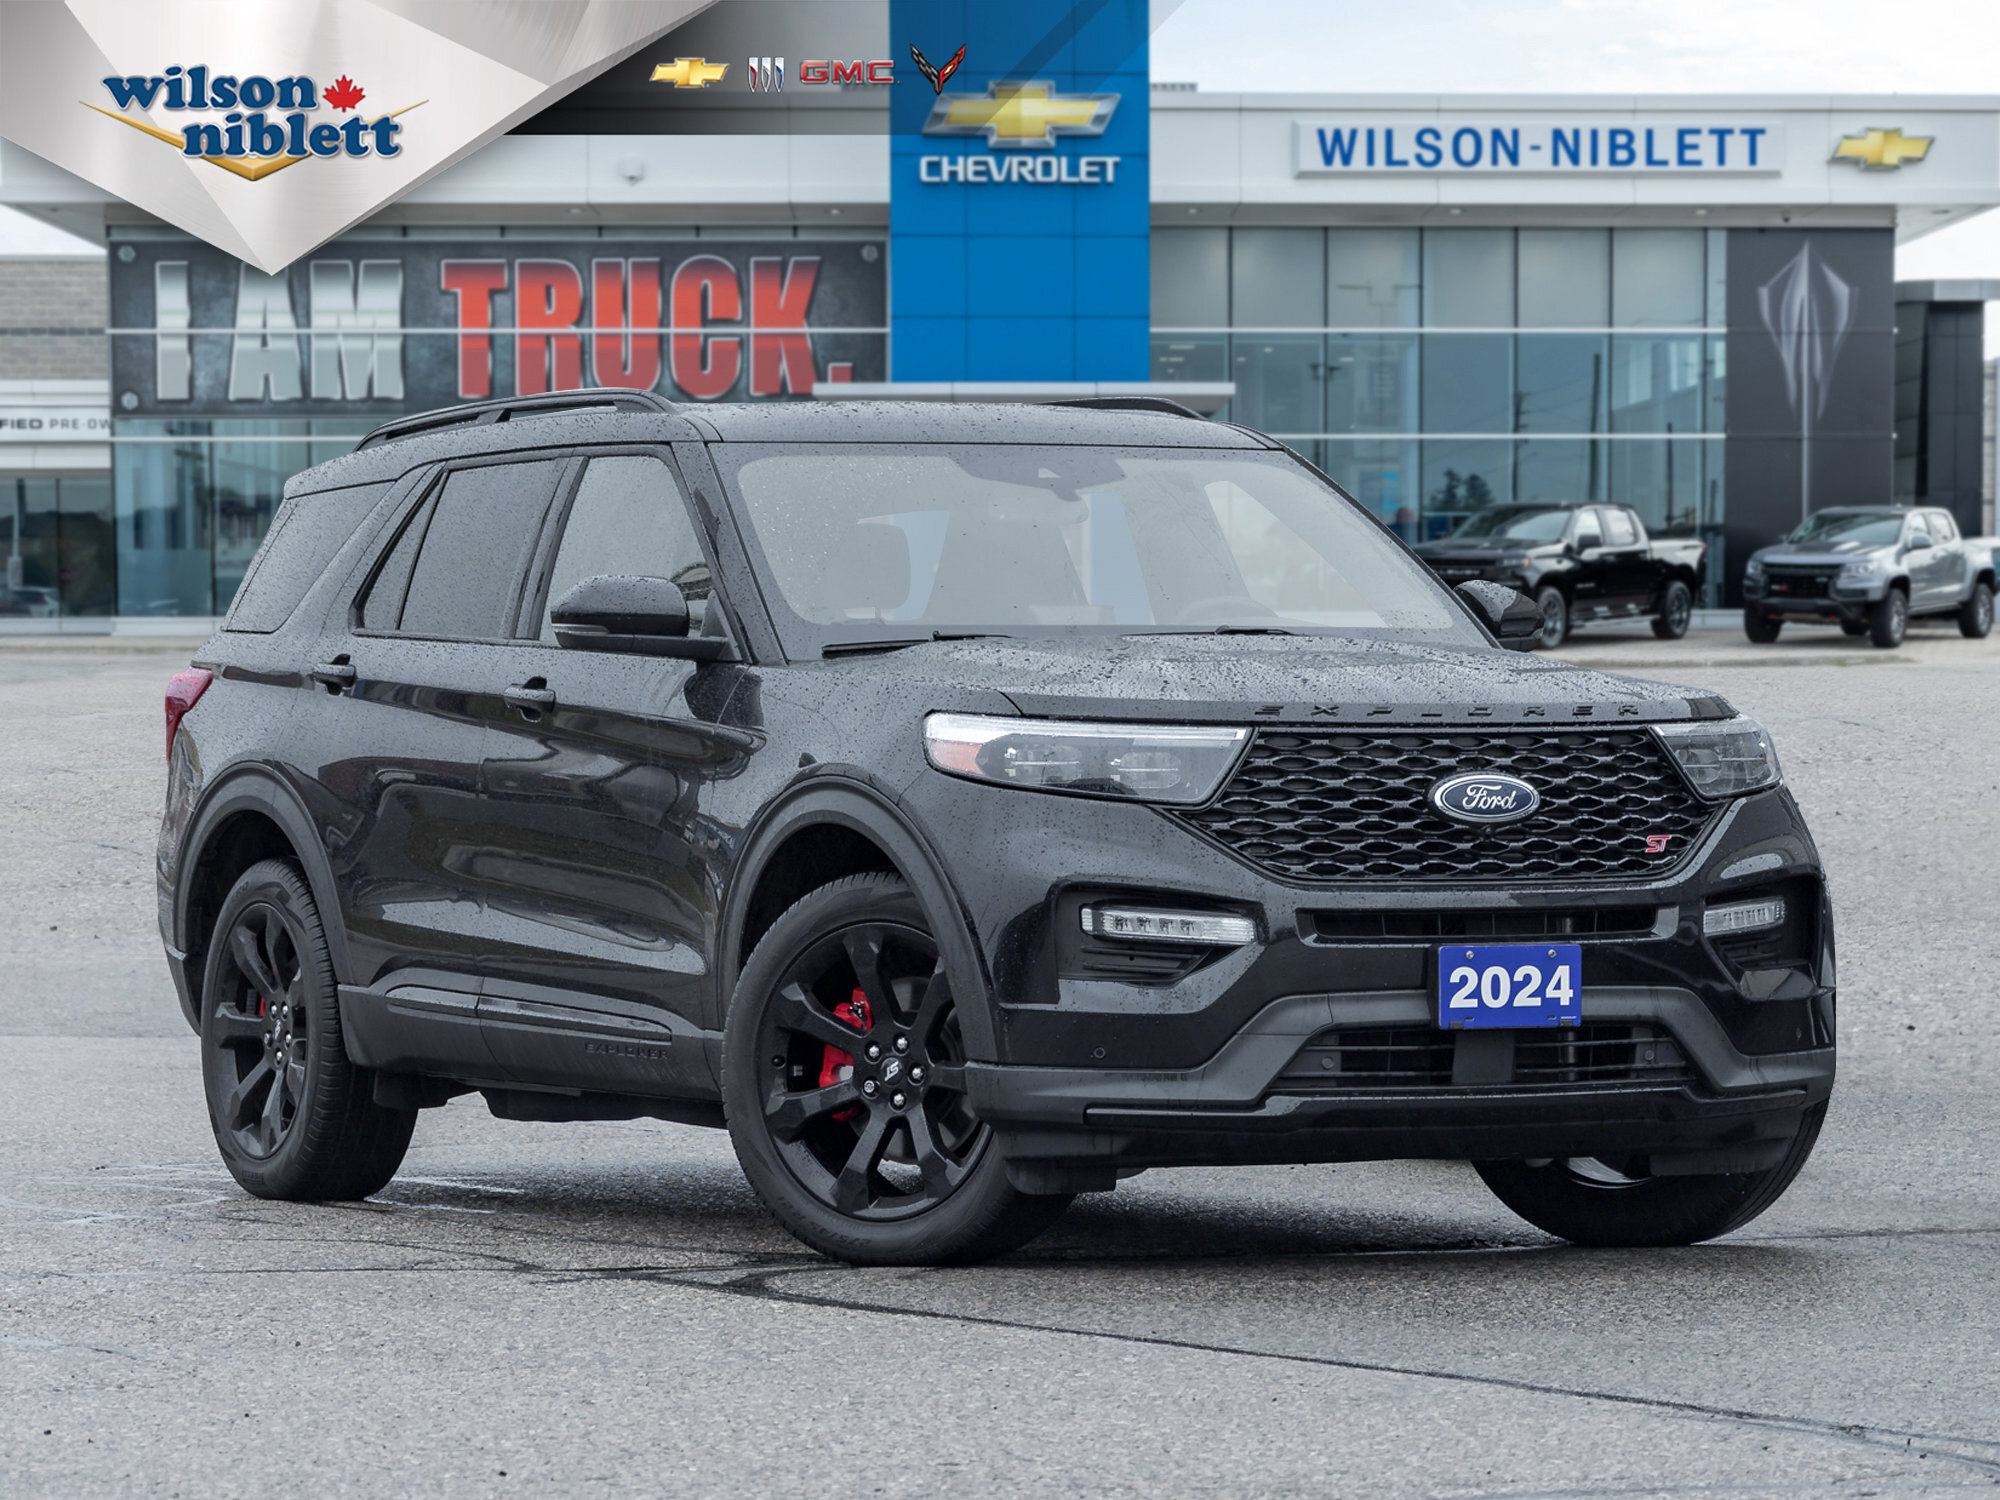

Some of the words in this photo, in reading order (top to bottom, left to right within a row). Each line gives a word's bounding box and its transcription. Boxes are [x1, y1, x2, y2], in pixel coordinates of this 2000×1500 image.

[1317, 127, 1767, 167] WILSON-NIBLETT
[919, 155, 1121, 183] CHEVROLET
[155, 260, 192, 400] I
[228, 258, 403, 401] AM
[1462, 783, 1517, 810] Ford
[1644, 834, 1673, 853] ST
[1449, 964, 1574, 1009] 2024
